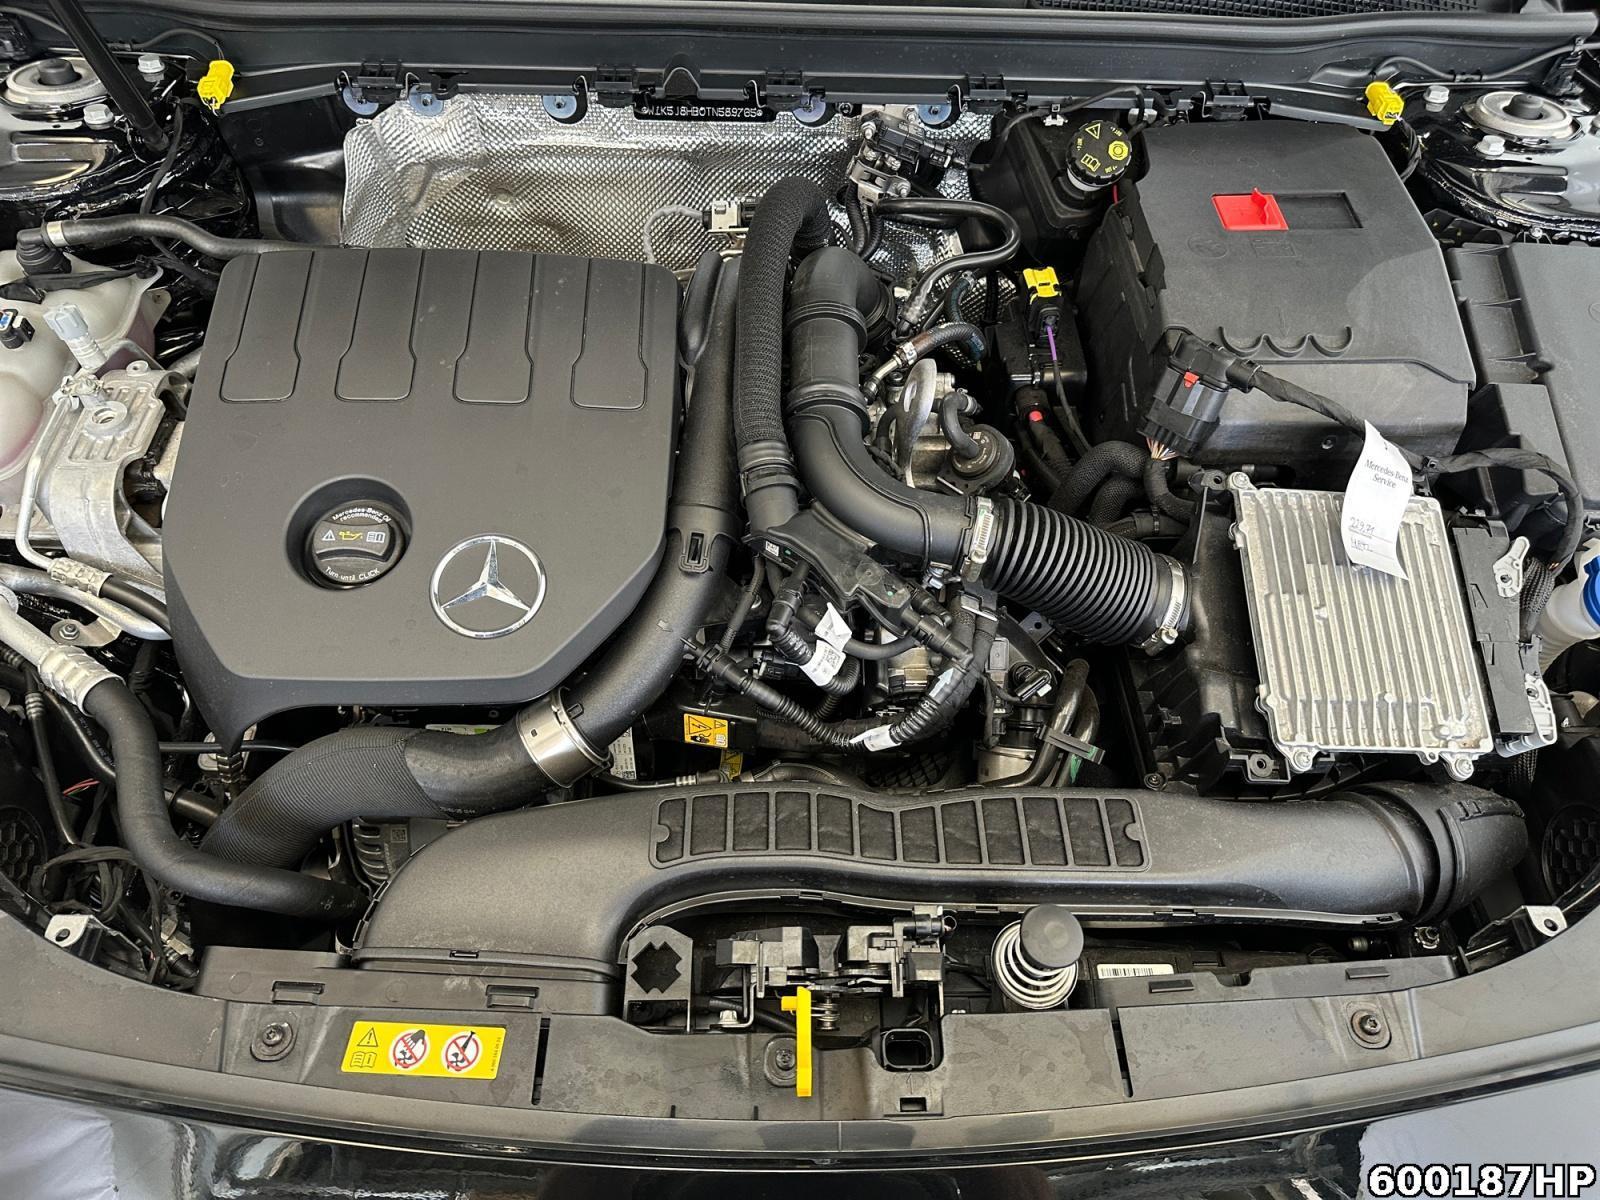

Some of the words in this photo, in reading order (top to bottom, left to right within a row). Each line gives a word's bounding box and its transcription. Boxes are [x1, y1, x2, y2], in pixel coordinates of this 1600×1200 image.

[1373, 473, 1397, 488] Service
[340, 512, 382, 523] recommended
[326, 566, 338, 578] Turn
[359, 568, 380, 579] CLICK
